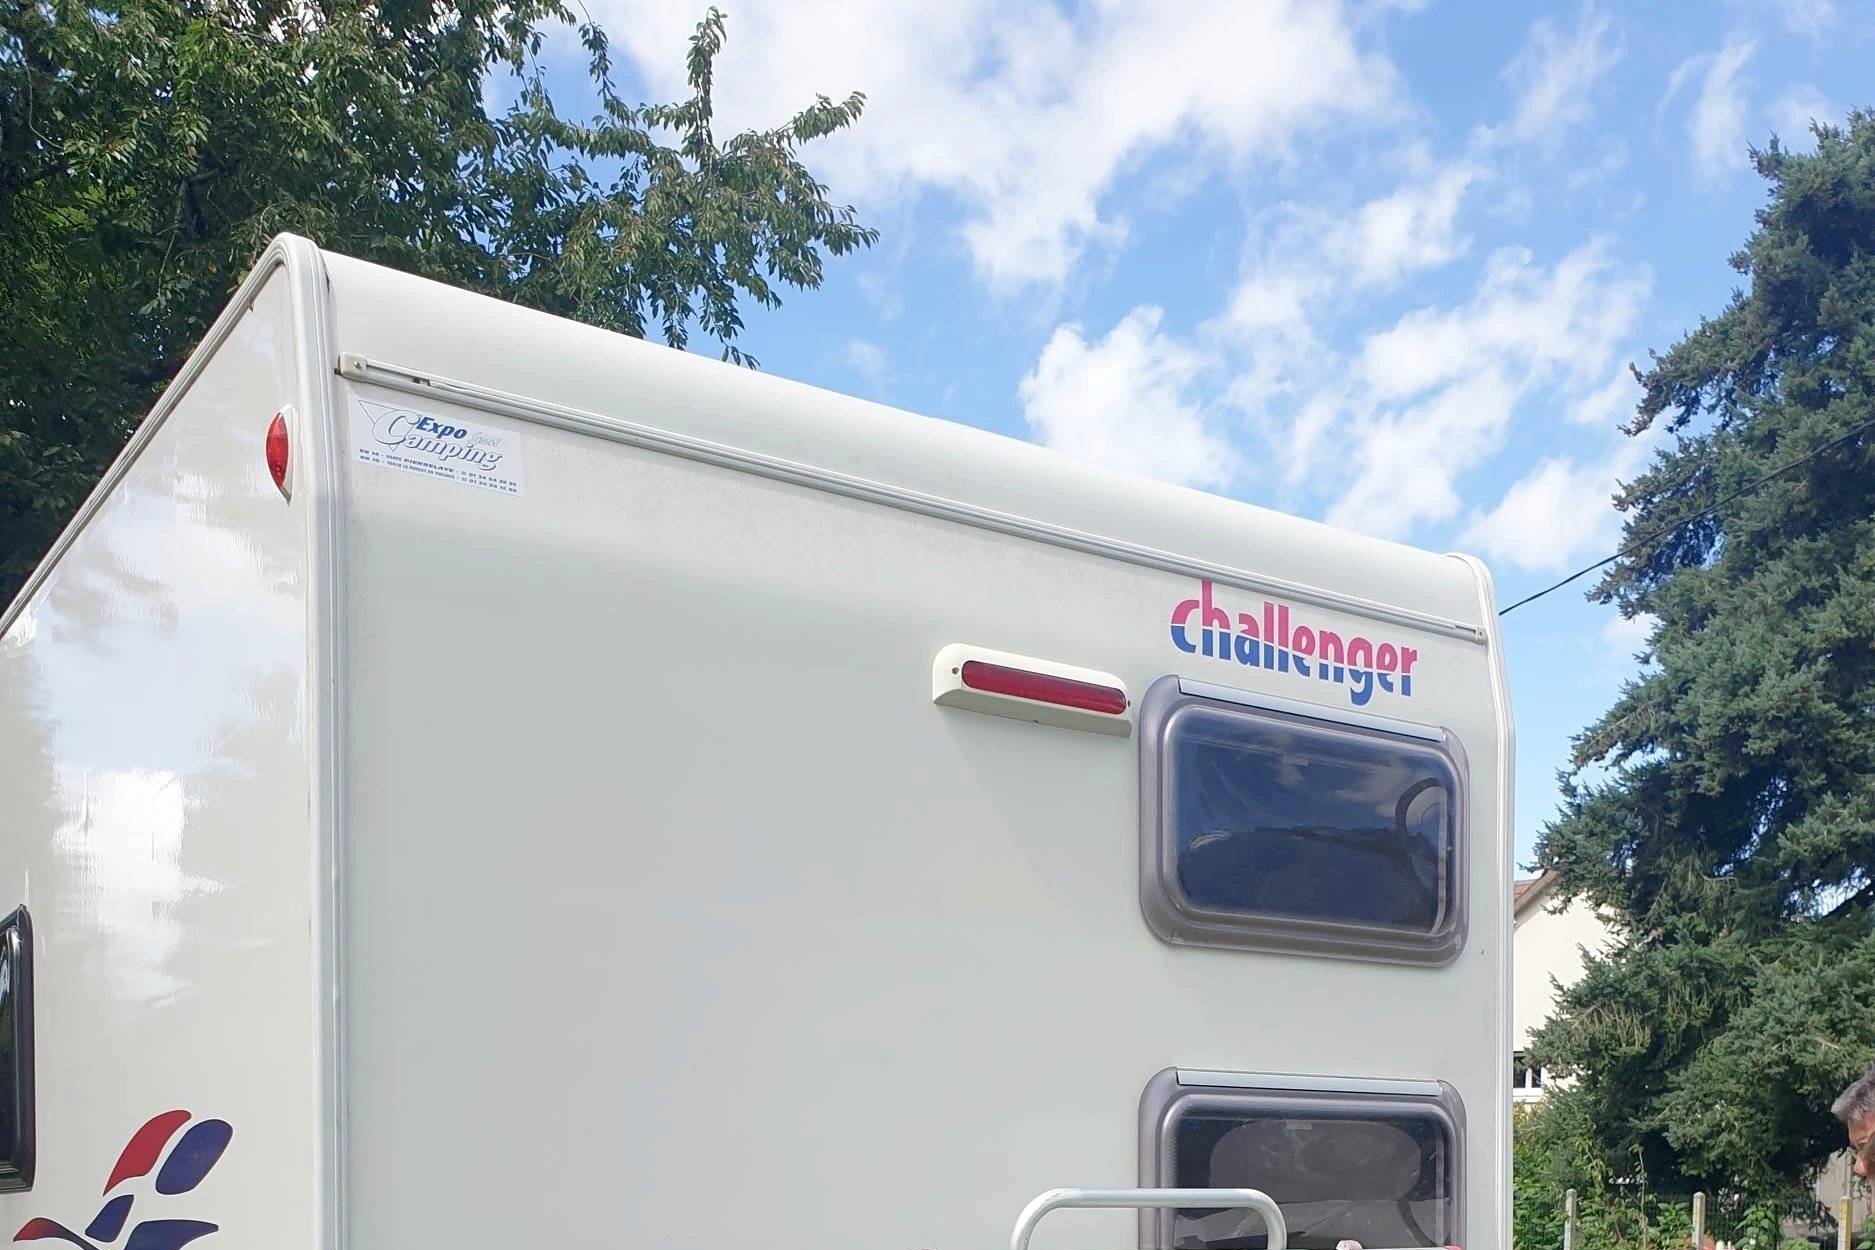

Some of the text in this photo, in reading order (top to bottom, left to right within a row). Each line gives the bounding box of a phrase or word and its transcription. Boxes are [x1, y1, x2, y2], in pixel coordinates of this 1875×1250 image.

[372, 409, 503, 471] Camping
[416, 416, 468, 439] Expo
[1170, 579, 1418, 706] challenger
